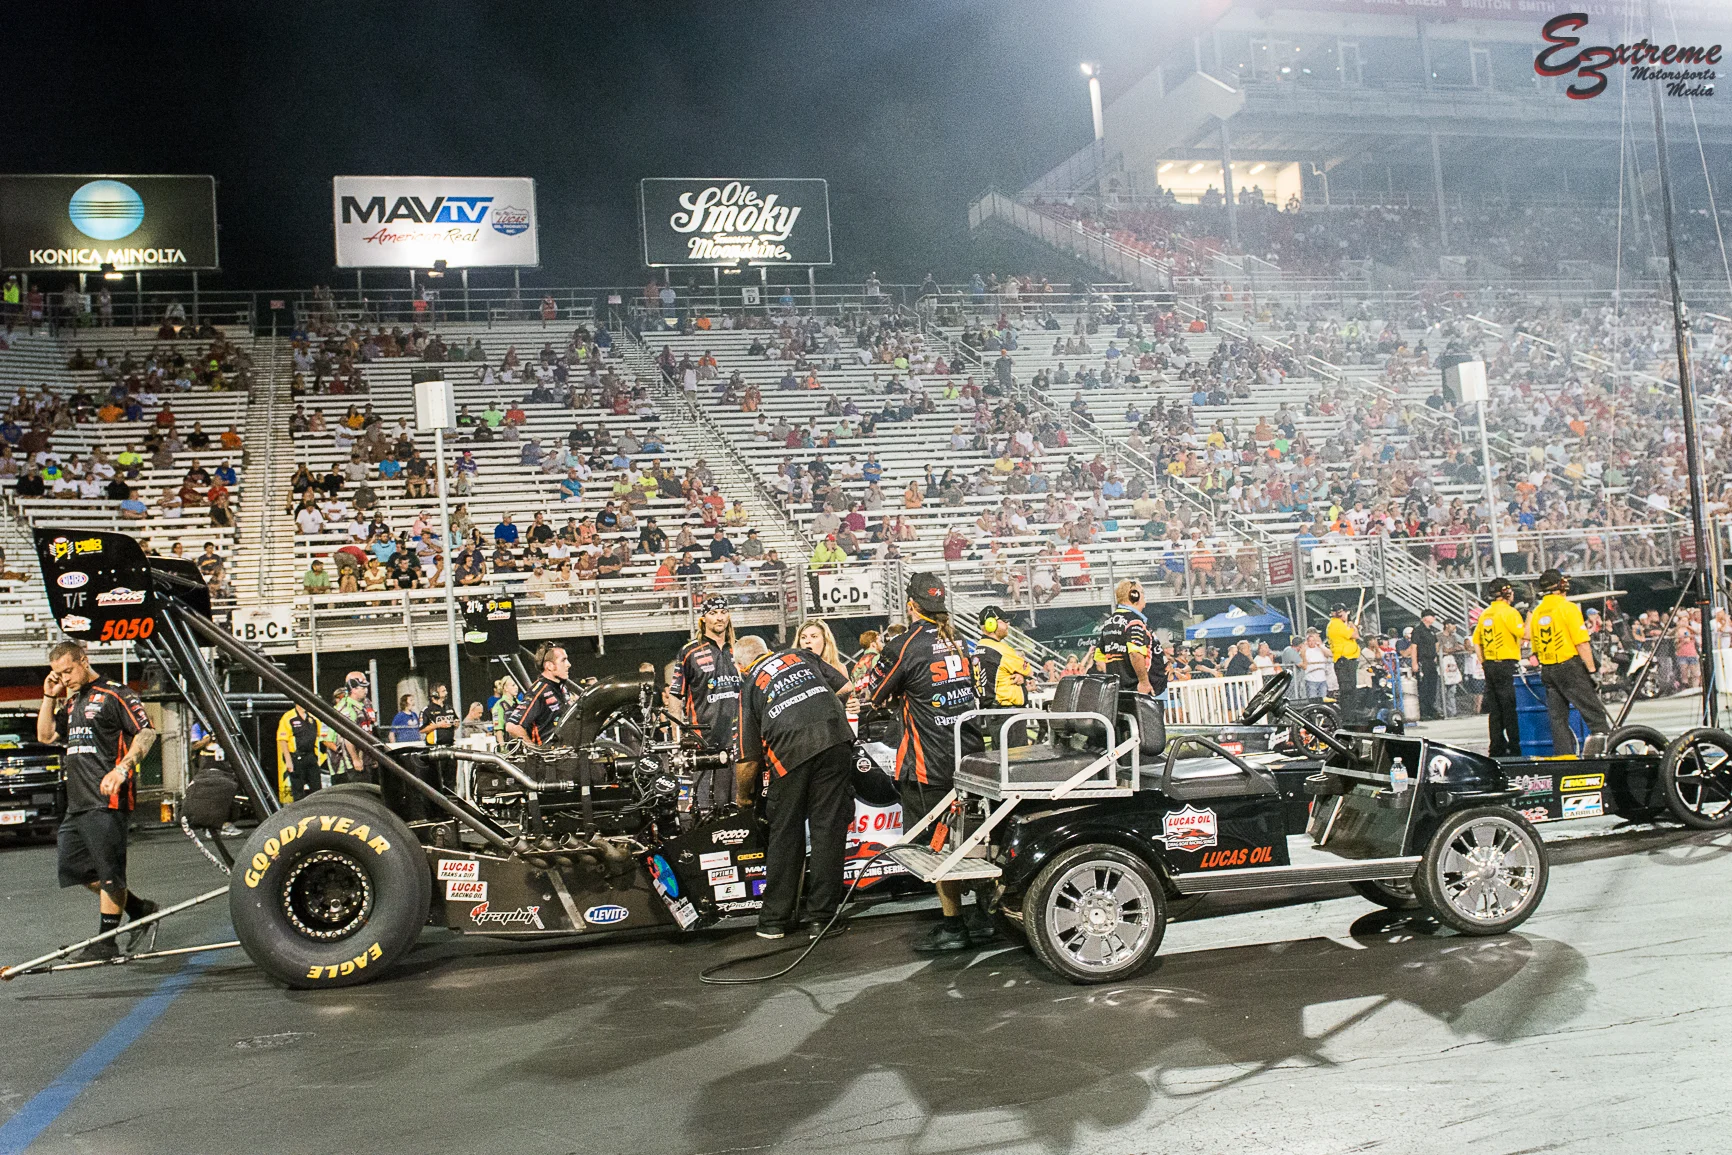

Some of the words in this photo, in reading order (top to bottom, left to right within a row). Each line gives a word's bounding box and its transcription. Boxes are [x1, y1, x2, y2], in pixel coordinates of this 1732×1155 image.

[1519, 1, 1556, 13] SMITH
[720, 181, 764, 207] Ole
[341, 196, 494, 224] MAVTV
[670, 186, 801, 242] Smoky
[496, 215, 527, 223] LUCAS
[362, 227, 442, 245] American
[29, 248, 103, 264] KONICA
[106, 248, 187, 264] MINOLTA
[688, 236, 792, 260] Moonshine
[63, 591, 87, 610] T/F
[100, 617, 155, 641] 5050
[773, 668, 814, 692] MARCK
[639, 756, 659, 769] MSD
[656, 777, 676, 789] MSD
[874, 811, 902, 831] OIL
[1168, 816, 1196, 827] LUCAS
[1197, 815, 1211, 824] OIL
[1564, 809, 1602, 818] CARRILLO
[737, 852, 765, 861] GEICO
[1200, 848, 1249, 868] LUCAS
[1249, 846, 1273, 864] OIL
[443, 861, 475, 872] LUCAS
[451, 882, 484, 893] LUCAS
[585, 906, 629, 922] CLEVITE
[306, 942, 383, 979] EAGLE
